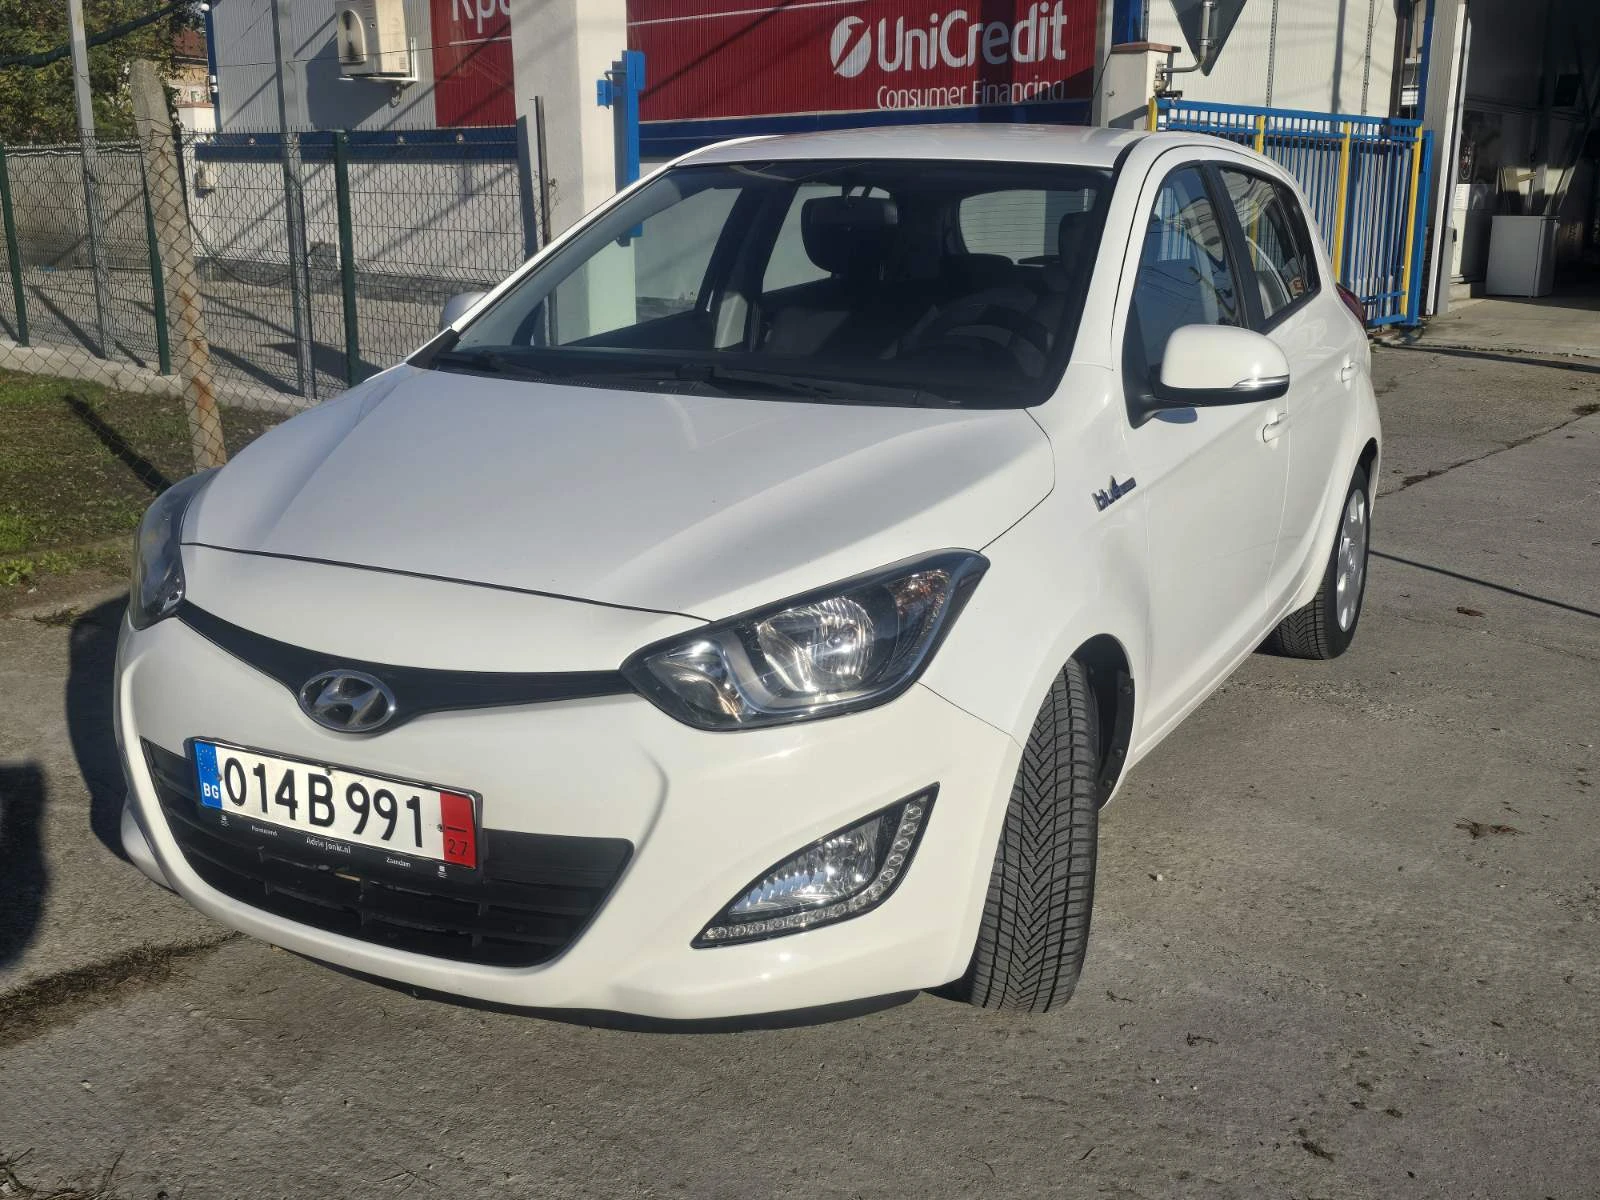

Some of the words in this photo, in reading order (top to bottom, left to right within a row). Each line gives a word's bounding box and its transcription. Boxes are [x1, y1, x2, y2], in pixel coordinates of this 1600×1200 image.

[877, 0, 1067, 72] UniCredit
[877, 83, 967, 109] Consumer
[203, 782, 219, 799] BG
[448, 839, 469, 857] 27
